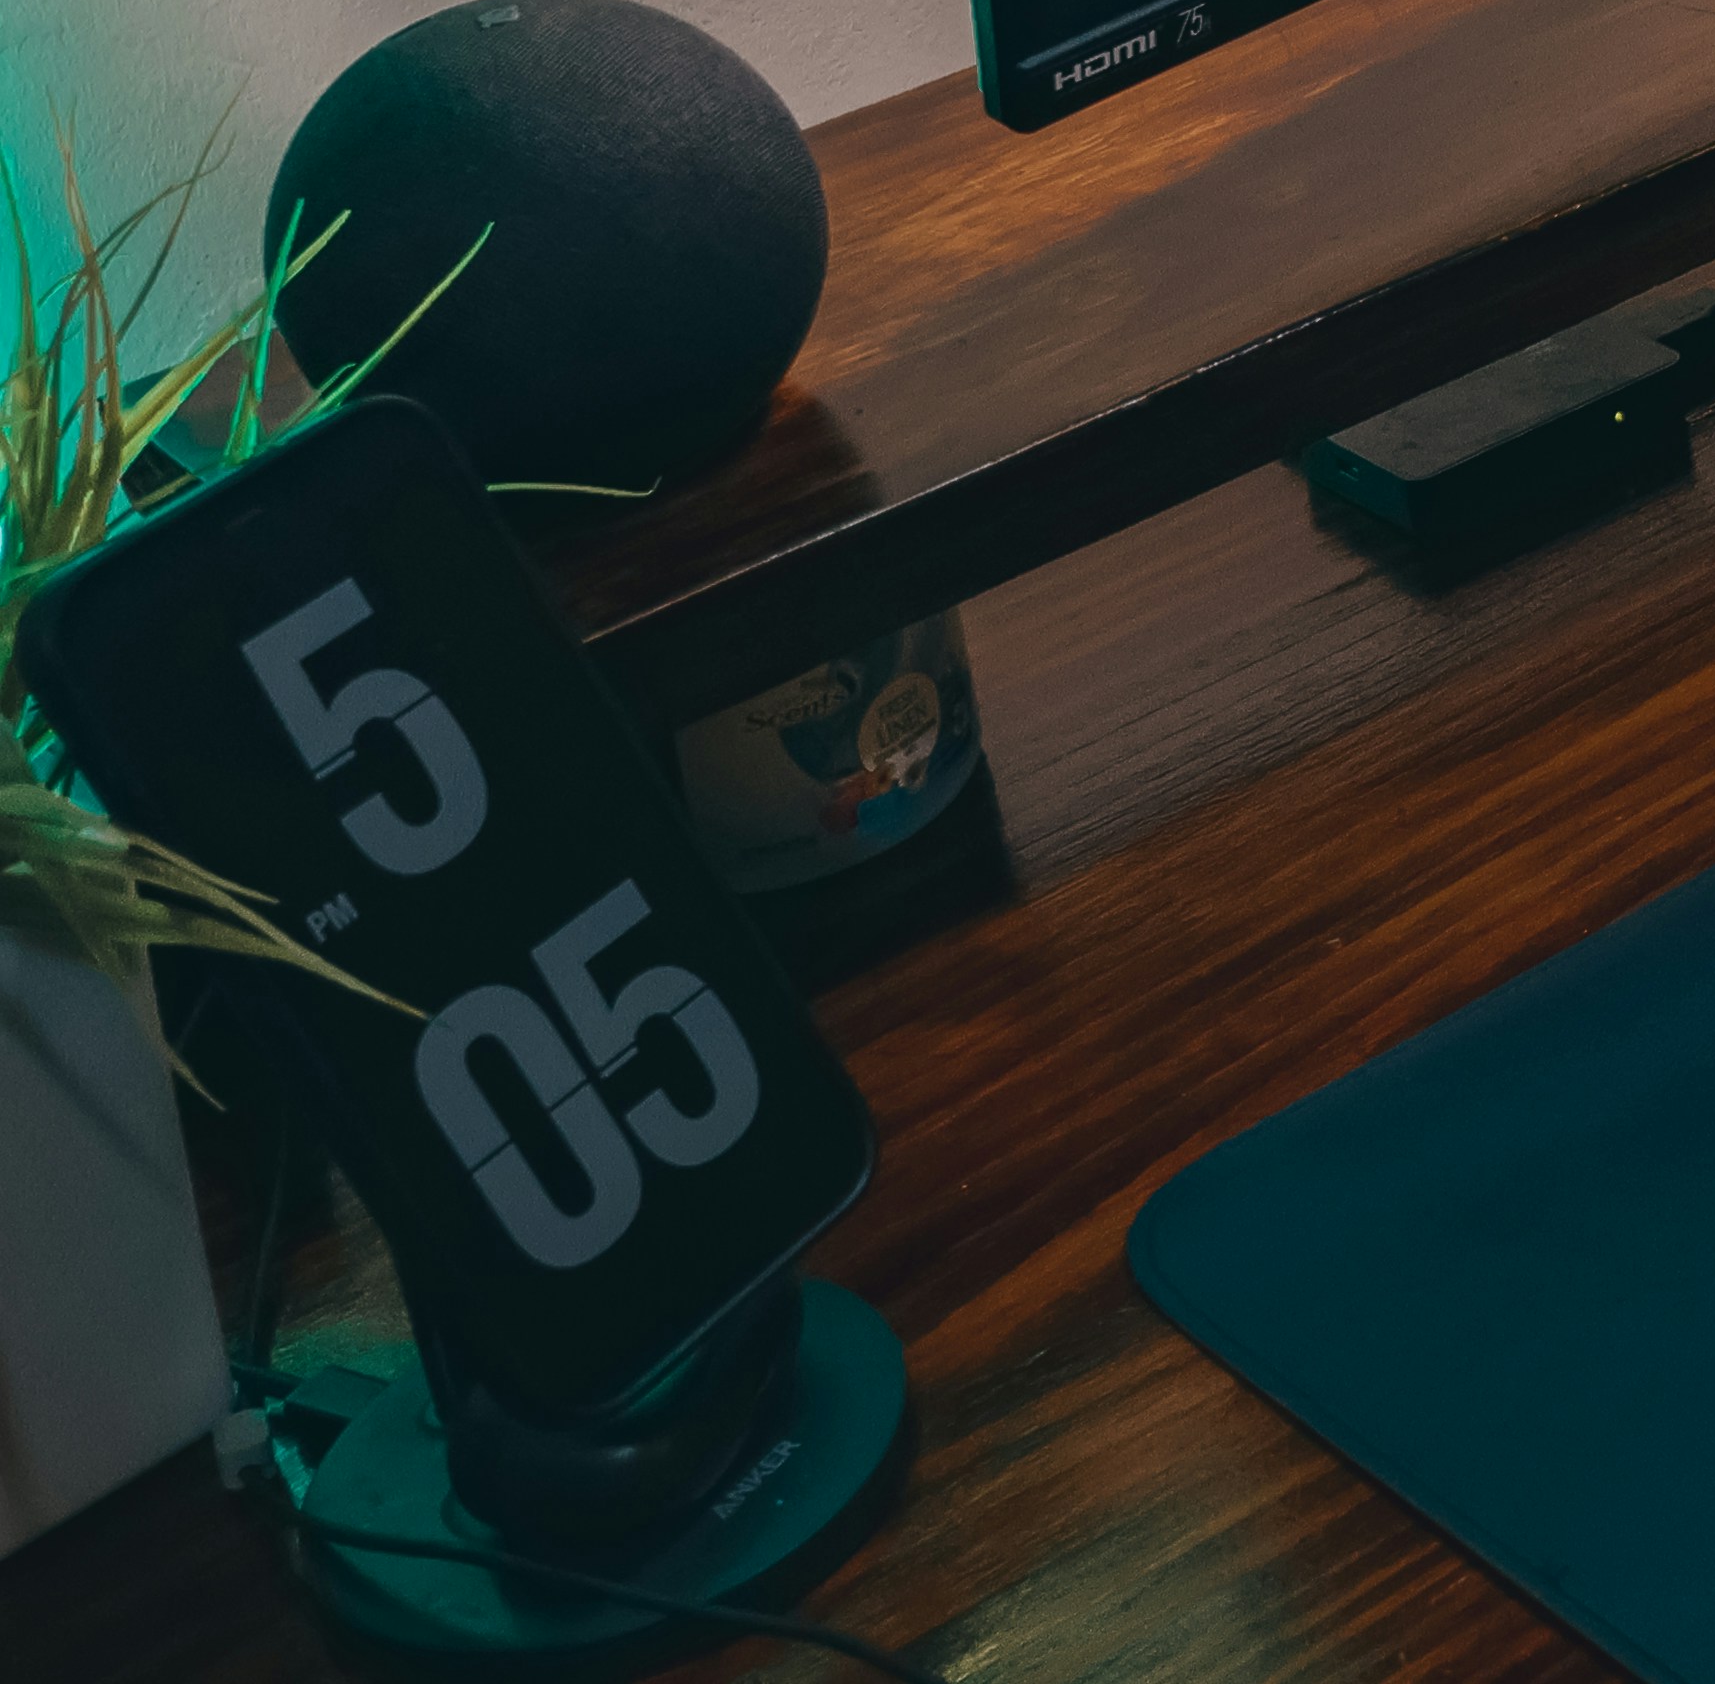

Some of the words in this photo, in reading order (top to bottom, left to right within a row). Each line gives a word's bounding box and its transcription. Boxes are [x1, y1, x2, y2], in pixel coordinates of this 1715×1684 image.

[1054, 29, 1157, 92] HDMI
[241, 577, 489, 876] 5
[305, 892, 360, 944] PM
[412, 877, 761, 1270] 05
[712, 1440, 802, 1519] ANKER
